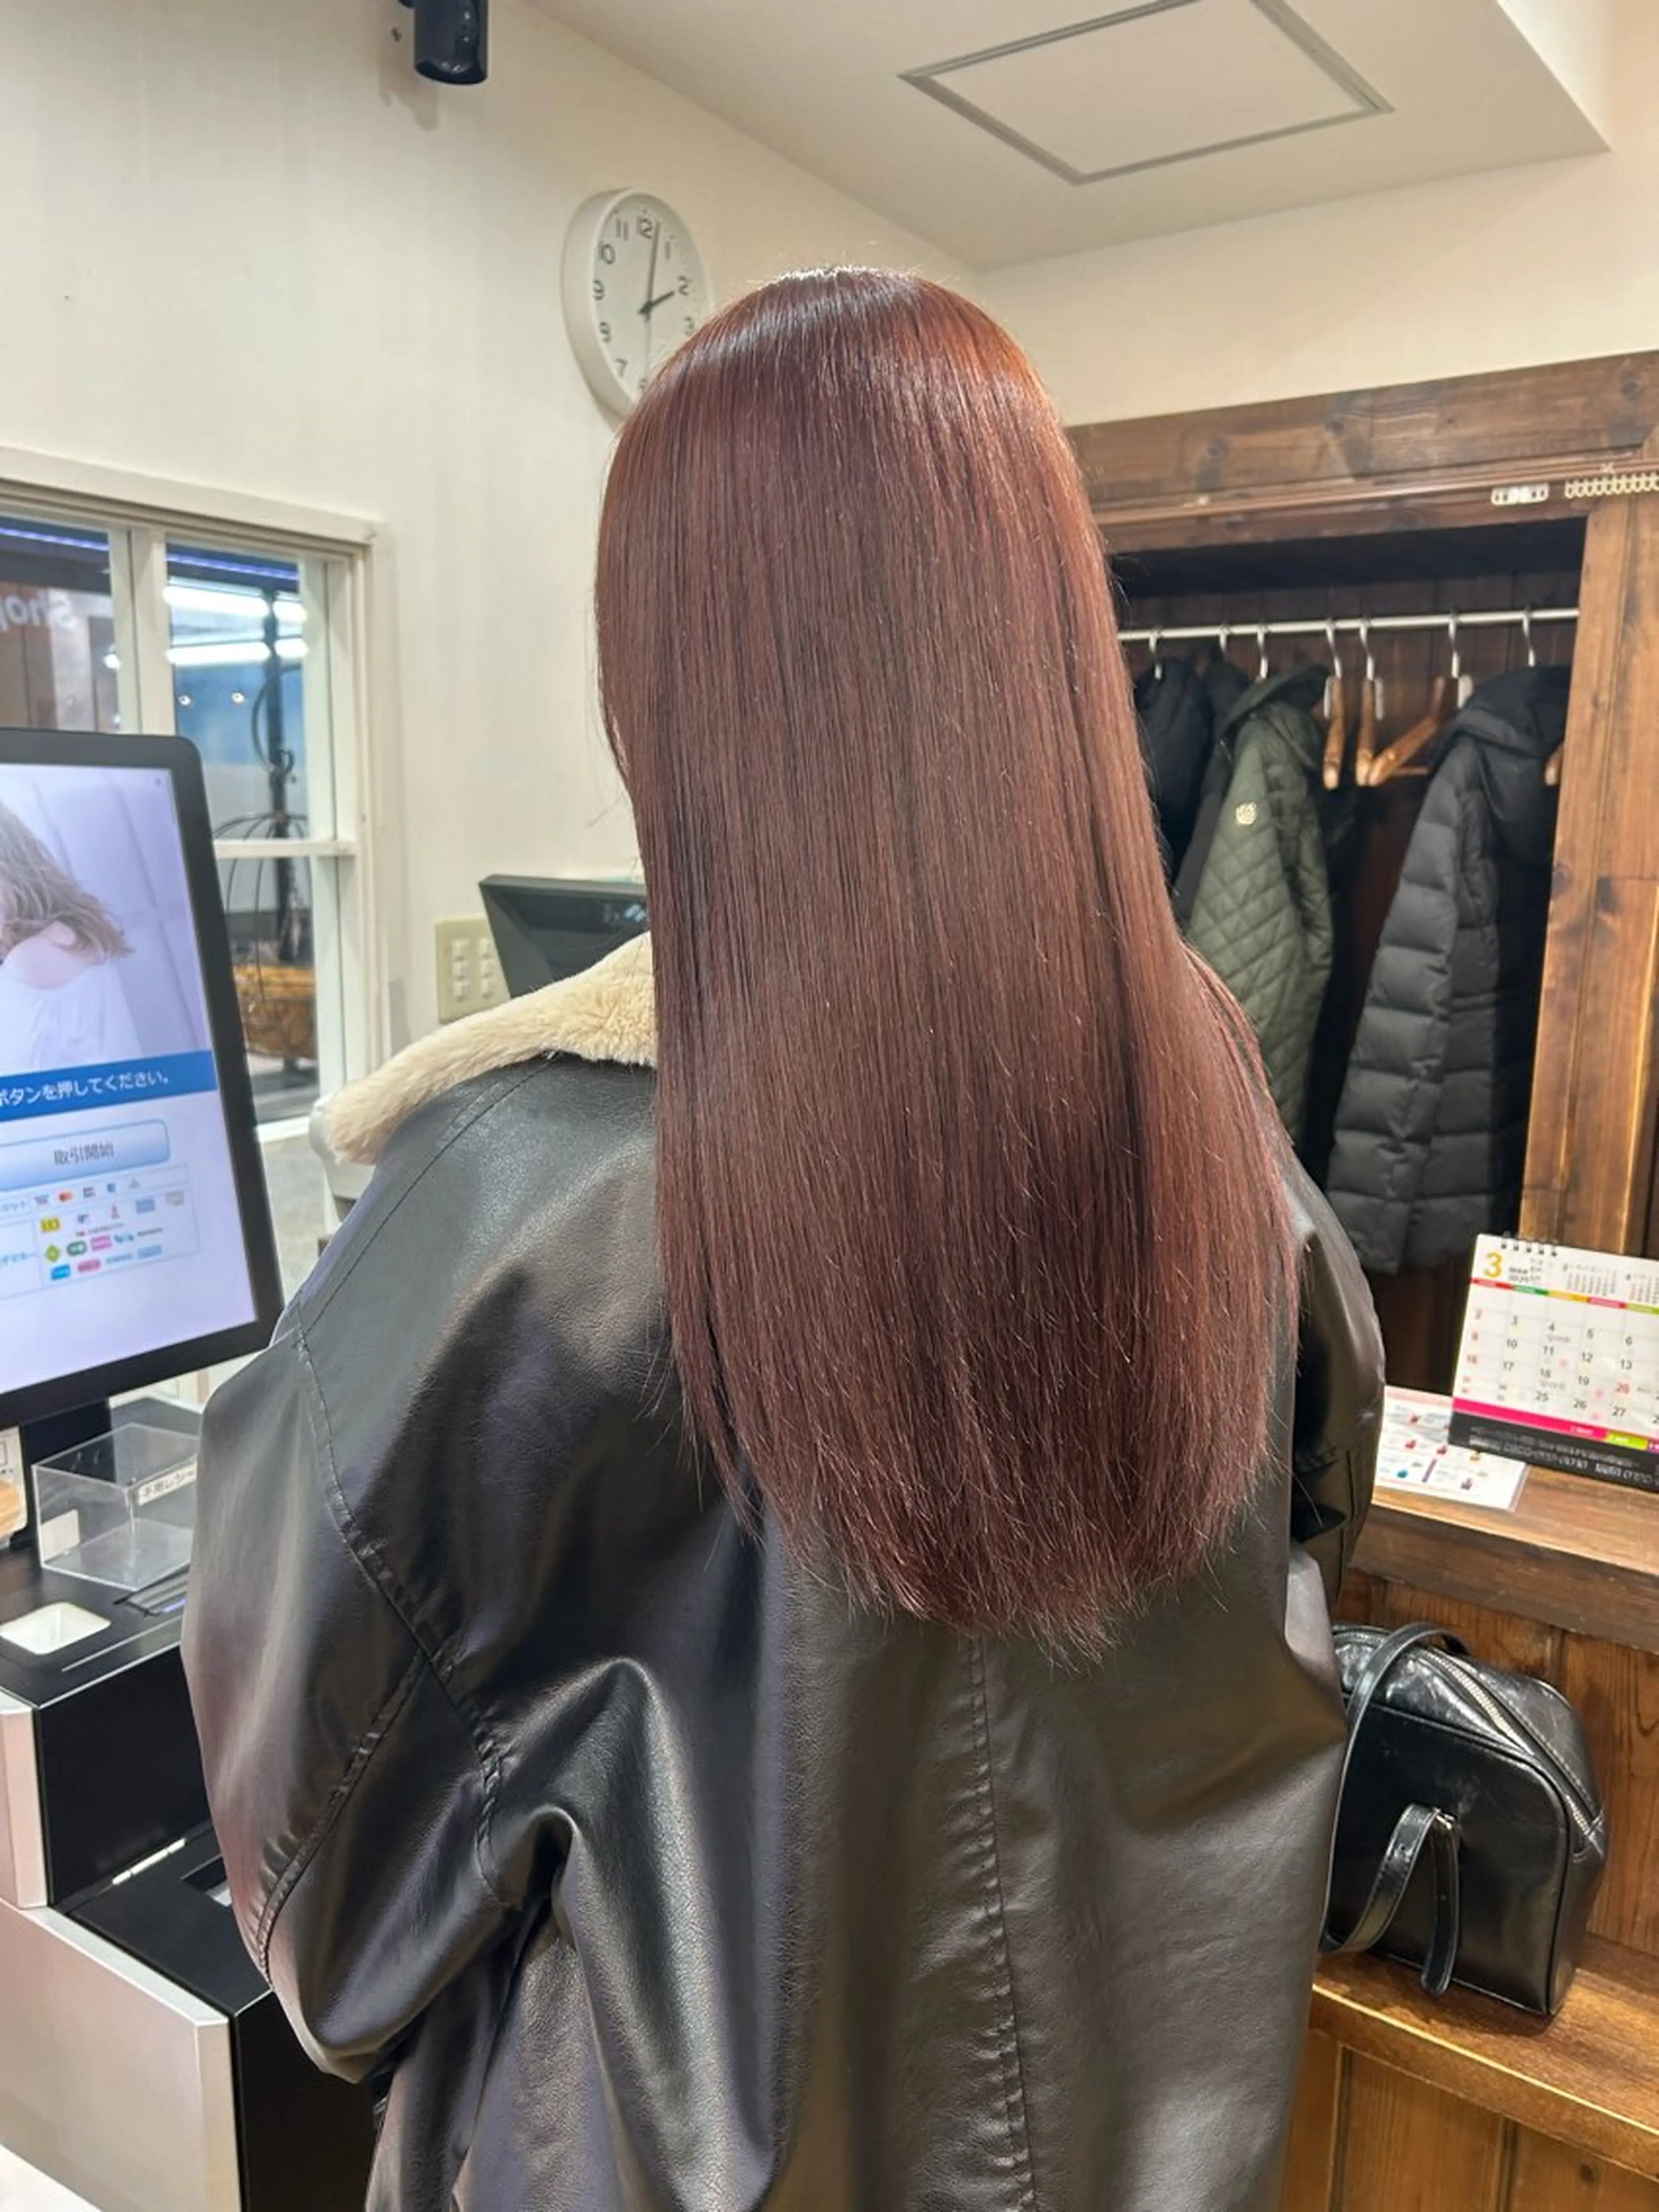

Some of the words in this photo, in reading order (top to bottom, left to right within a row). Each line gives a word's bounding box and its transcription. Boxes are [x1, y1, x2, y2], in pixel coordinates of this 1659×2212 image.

[616, 218, 629, 241] 11
[636, 216, 653, 239] 12
[593, 279, 604, 301] 9
[678, 275, 691, 296] 2
[615, 358, 629, 377] 7
[1484, 1251, 1503, 1278] 3
[1547, 1321, 1555, 1332] 4
[1625, 1335, 1633, 1346] 6
[1506, 1339, 1517, 1350] 10
[1543, 1345, 1554, 1355] 11
[1581, 1351, 1593, 1363] 12
[1621, 1358, 1633, 1370] 13
[1503, 1361, 1514, 1371] 17
[1540, 1367, 1552, 1379] 18
[1578, 1375, 1590, 1386] 19
[1535, 1390, 1549, 1402] 25
[1573, 1398, 1587, 1410] 26
[1612, 1405, 1626, 1417] 27
